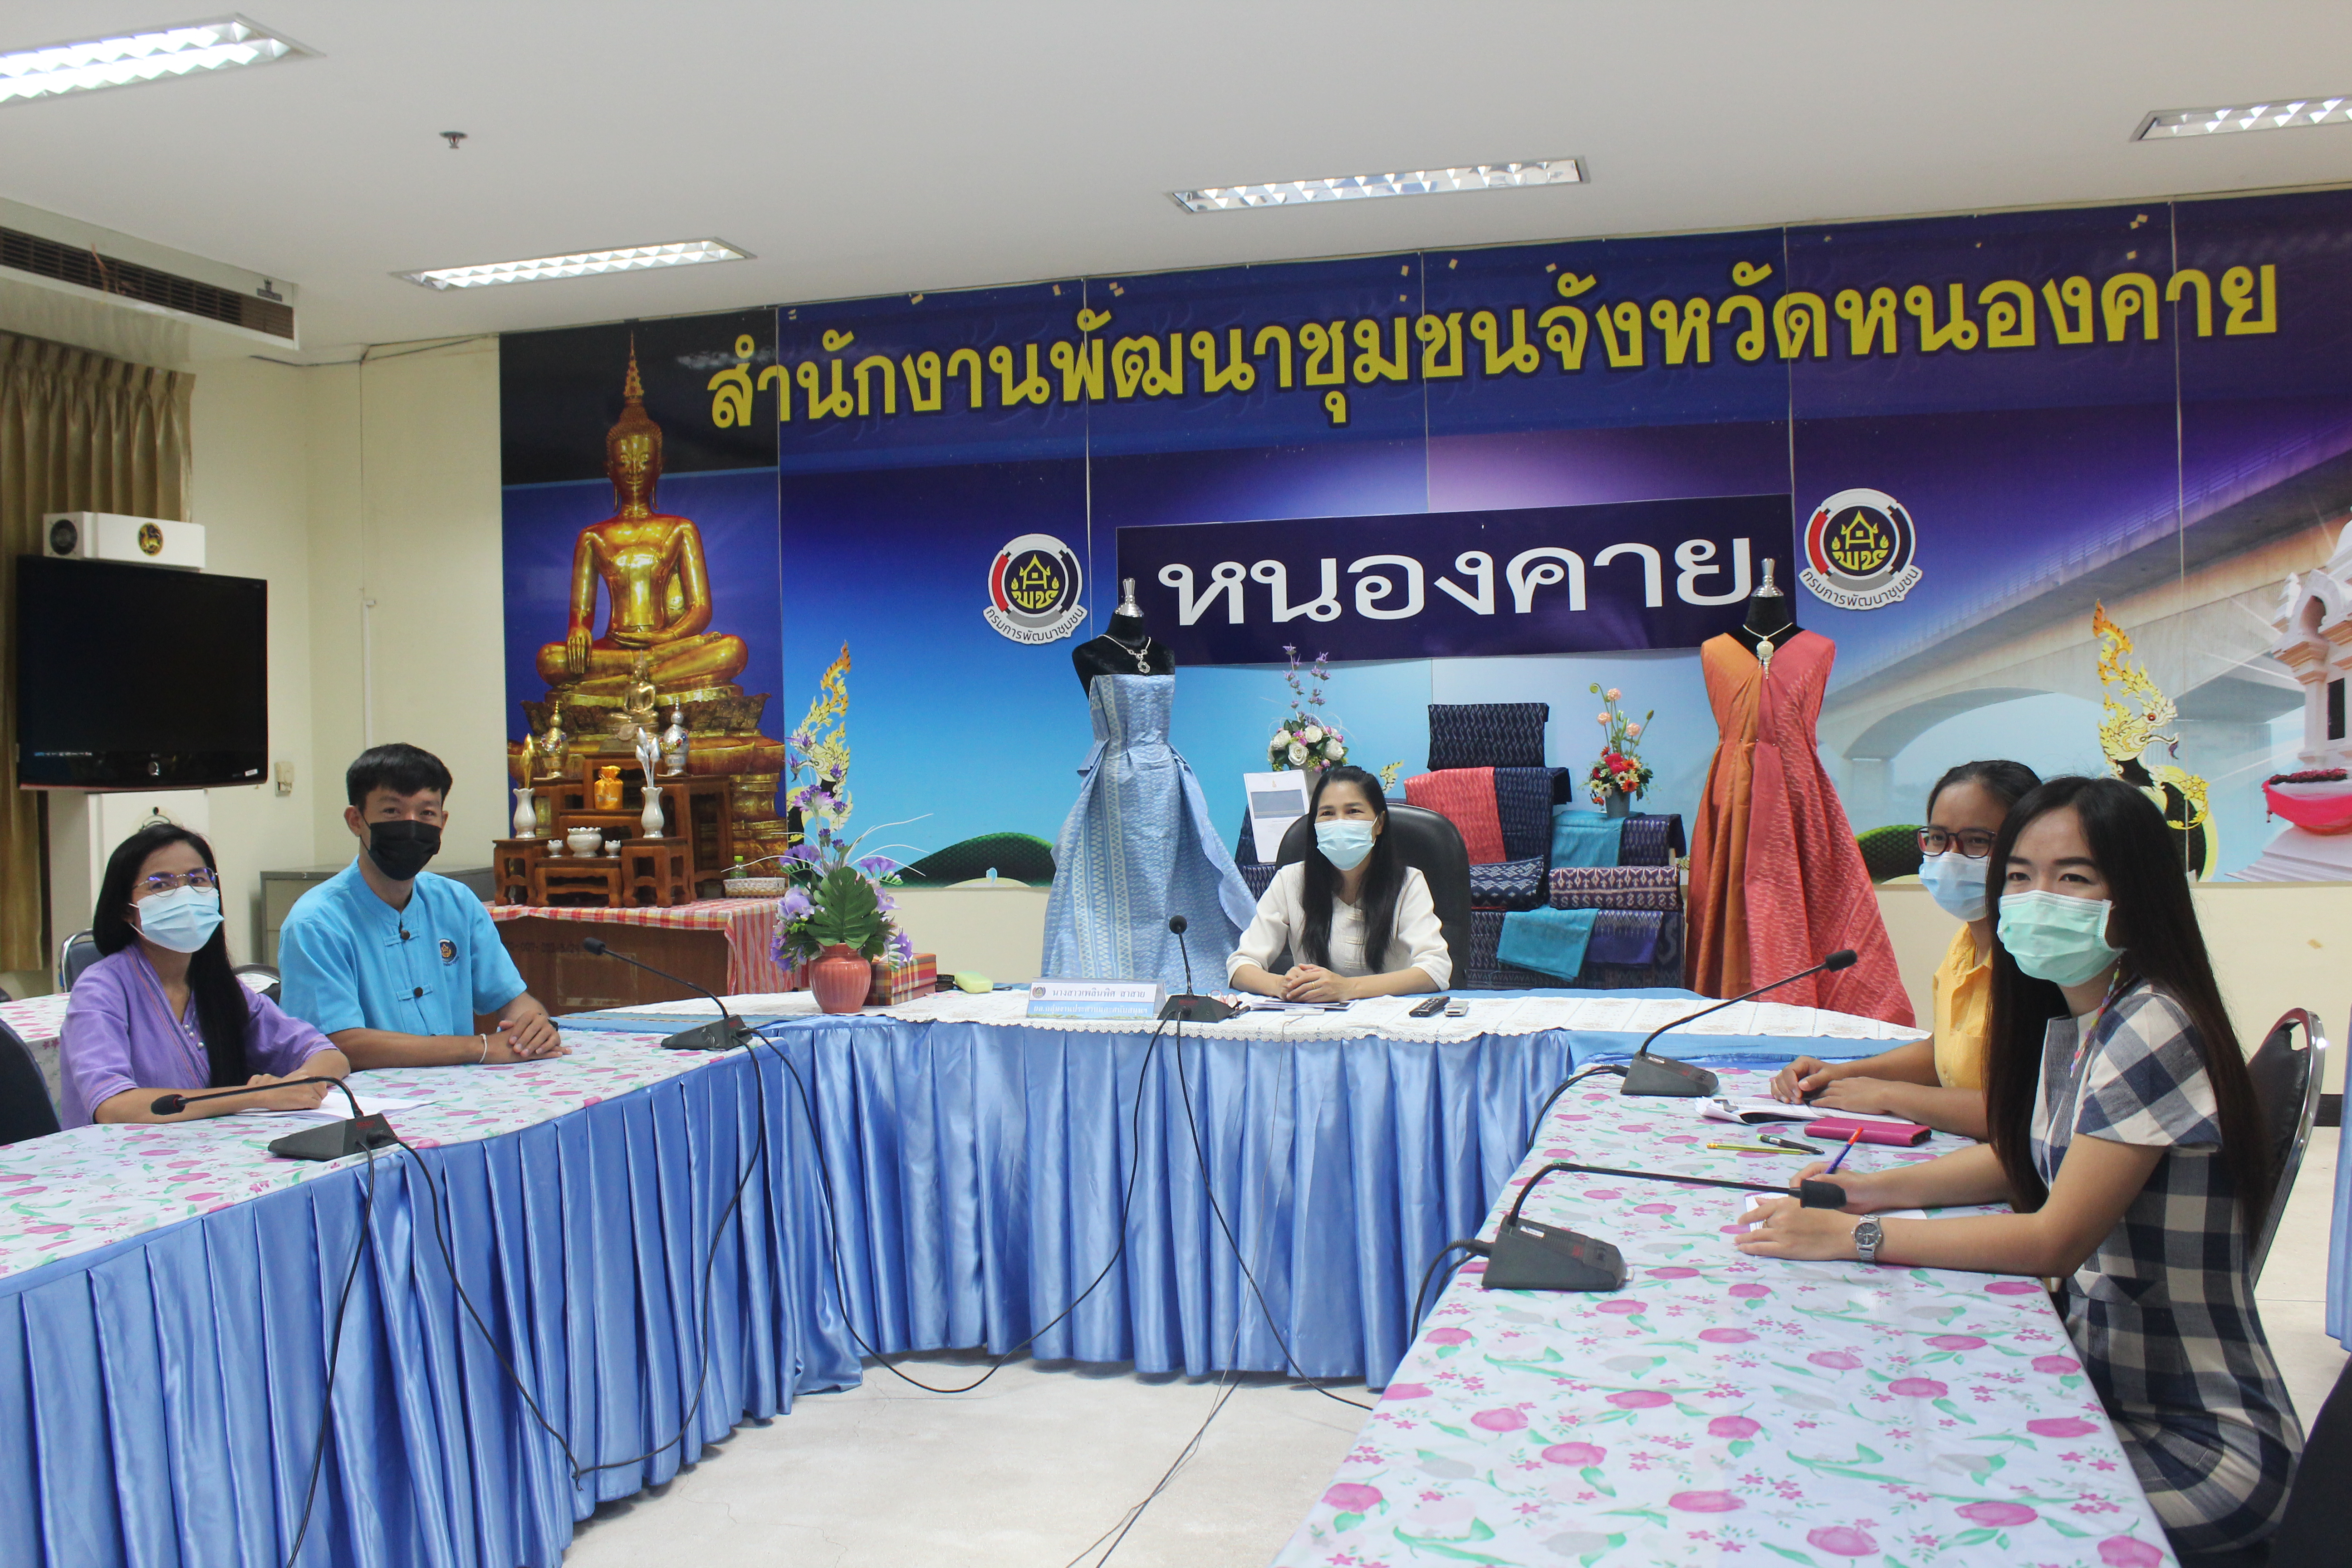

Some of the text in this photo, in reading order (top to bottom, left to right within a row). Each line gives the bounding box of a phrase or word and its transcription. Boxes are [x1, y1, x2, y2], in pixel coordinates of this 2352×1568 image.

[707, 261, 2277, 428] สำนักงานพัฒนาชุมชนจังหวัดหนองคาย
[1158, 537, 1751, 626] หนองคาย
[1803, 568, 1919, 607] กรมการพัฒนาชุมชน
[986, 608, 1084, 641] กรมการพัฒนาชุมชน
